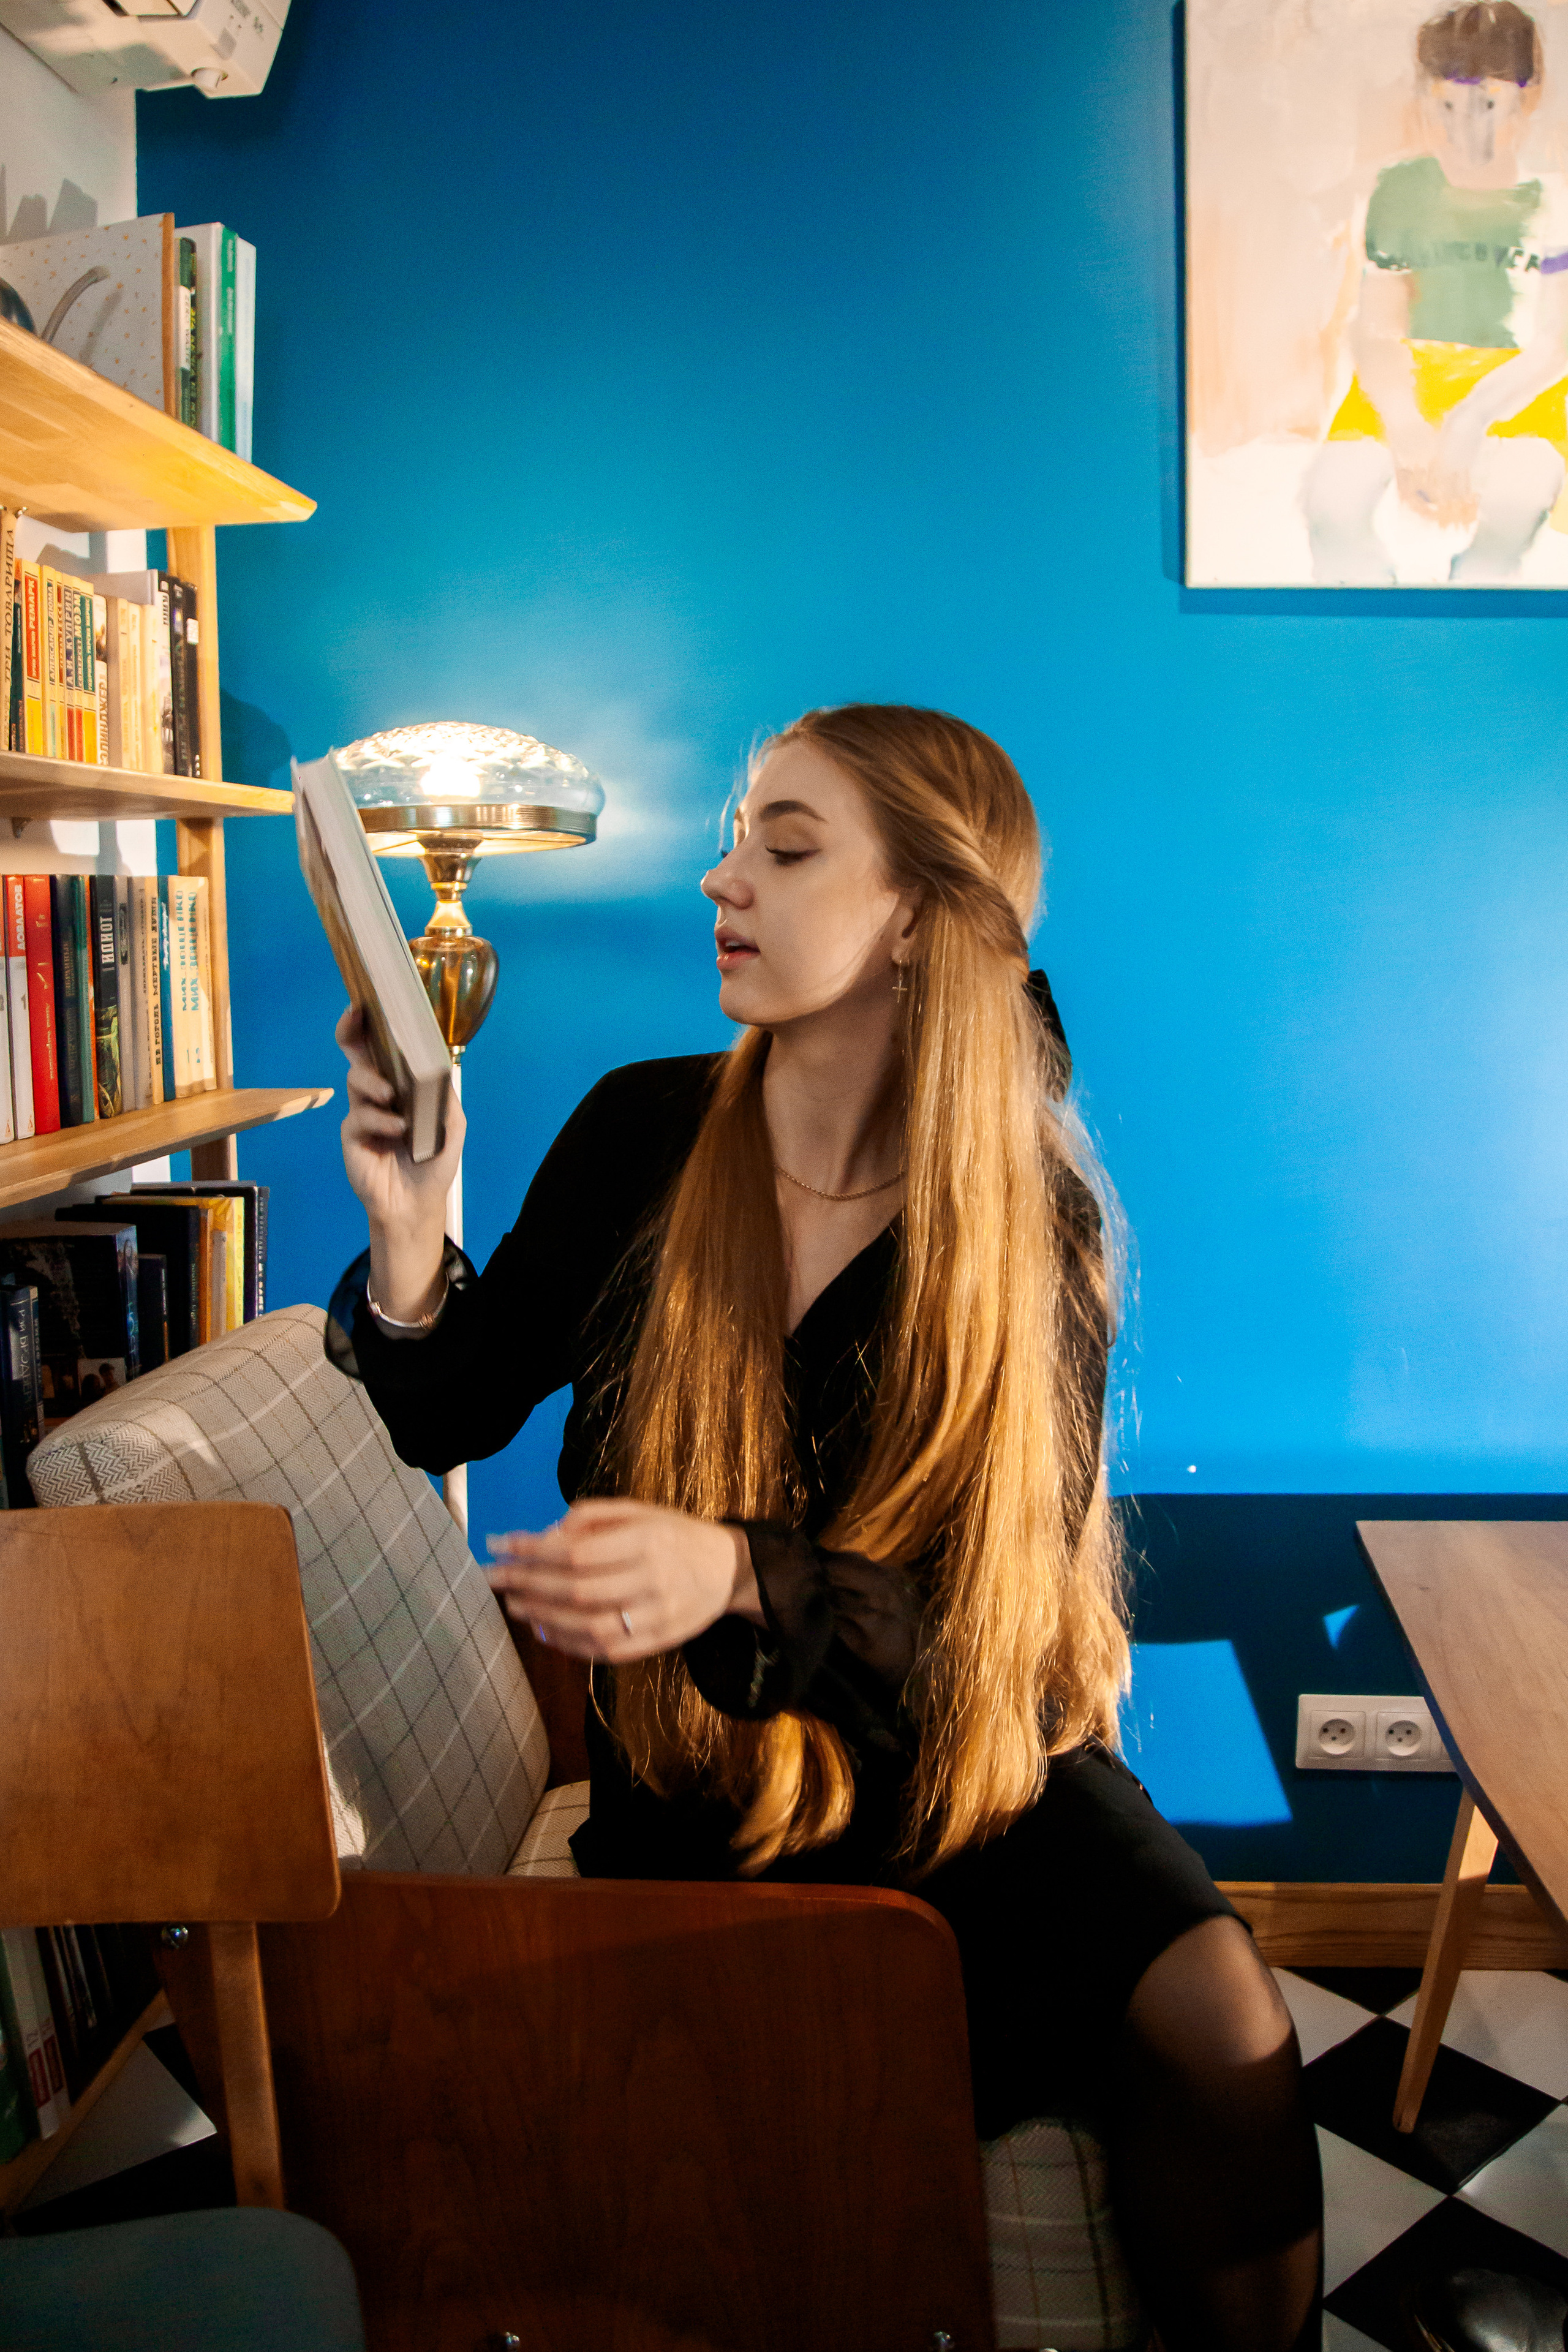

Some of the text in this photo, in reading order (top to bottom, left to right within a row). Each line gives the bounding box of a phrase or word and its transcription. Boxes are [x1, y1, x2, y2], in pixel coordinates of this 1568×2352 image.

[5, 529, 14, 636] ТОВАРИЩА
[64, 590, 73, 650] КУПРИН
[74, 594, 82, 638] МОЭМ
[14, 884, 26, 951] ДОВЛАТОВ
[100, 916, 115, 964] ИДИОТ
